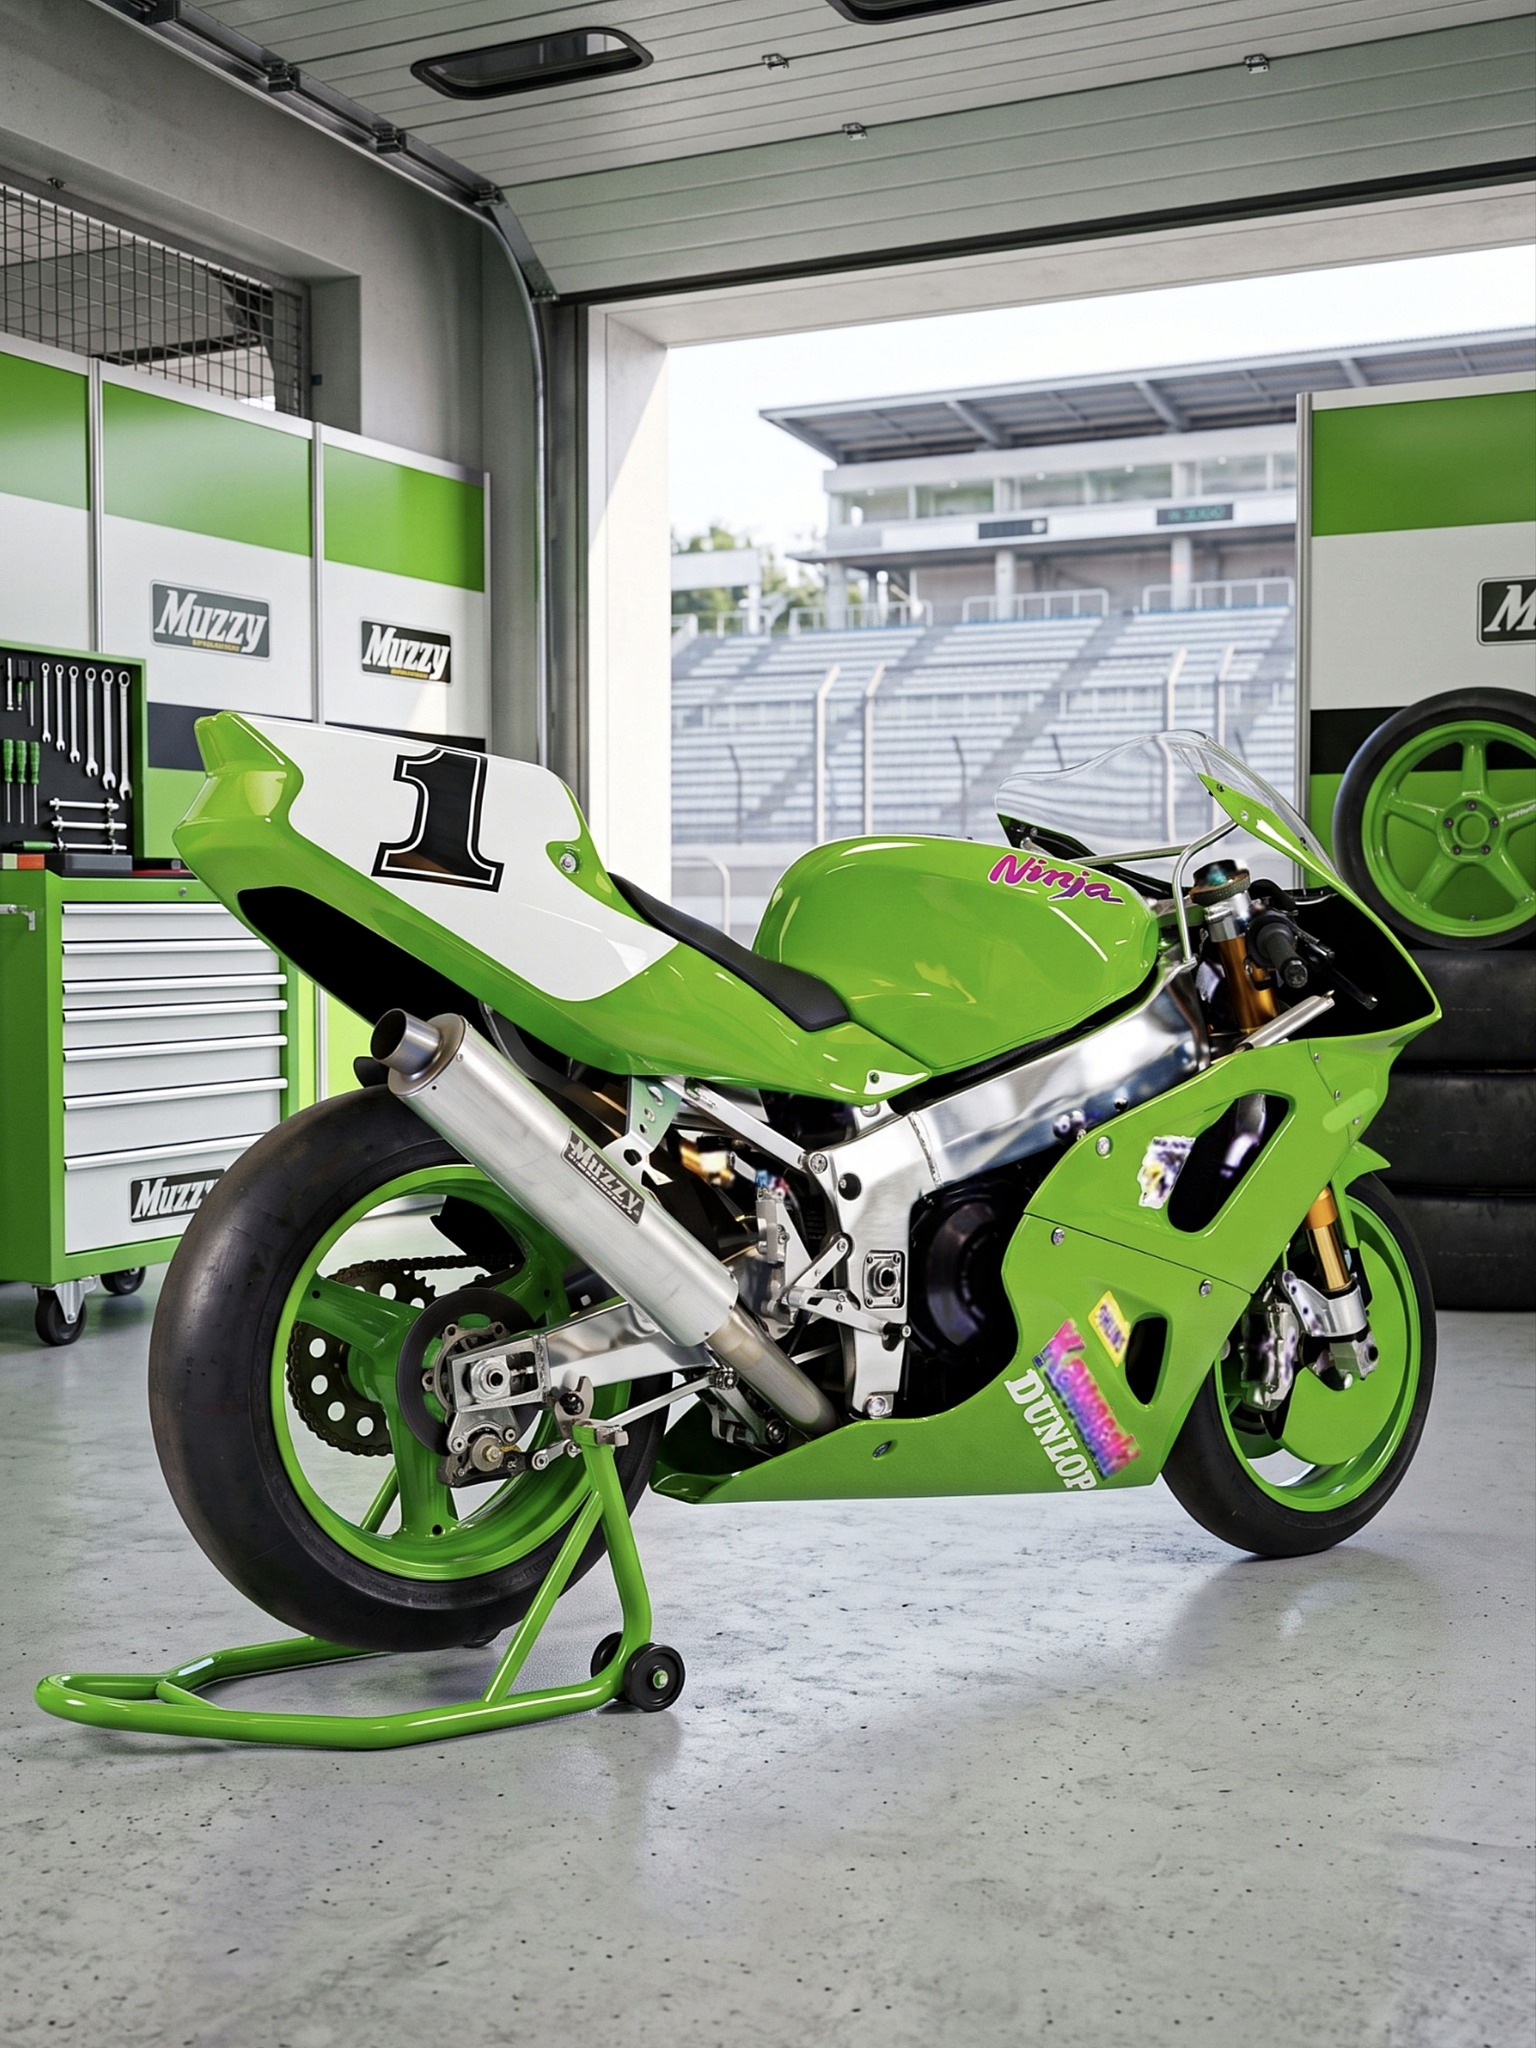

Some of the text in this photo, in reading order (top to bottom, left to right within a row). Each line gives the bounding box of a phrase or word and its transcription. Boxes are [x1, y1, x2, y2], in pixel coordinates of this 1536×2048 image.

[154, 589, 268, 654] Muzzy
[362, 625, 450, 680] Muzzy
[371, 746, 505, 893] 1
[988, 853, 1125, 905] Ninja
[1004, 1368, 1098, 1490] DUNLOP
